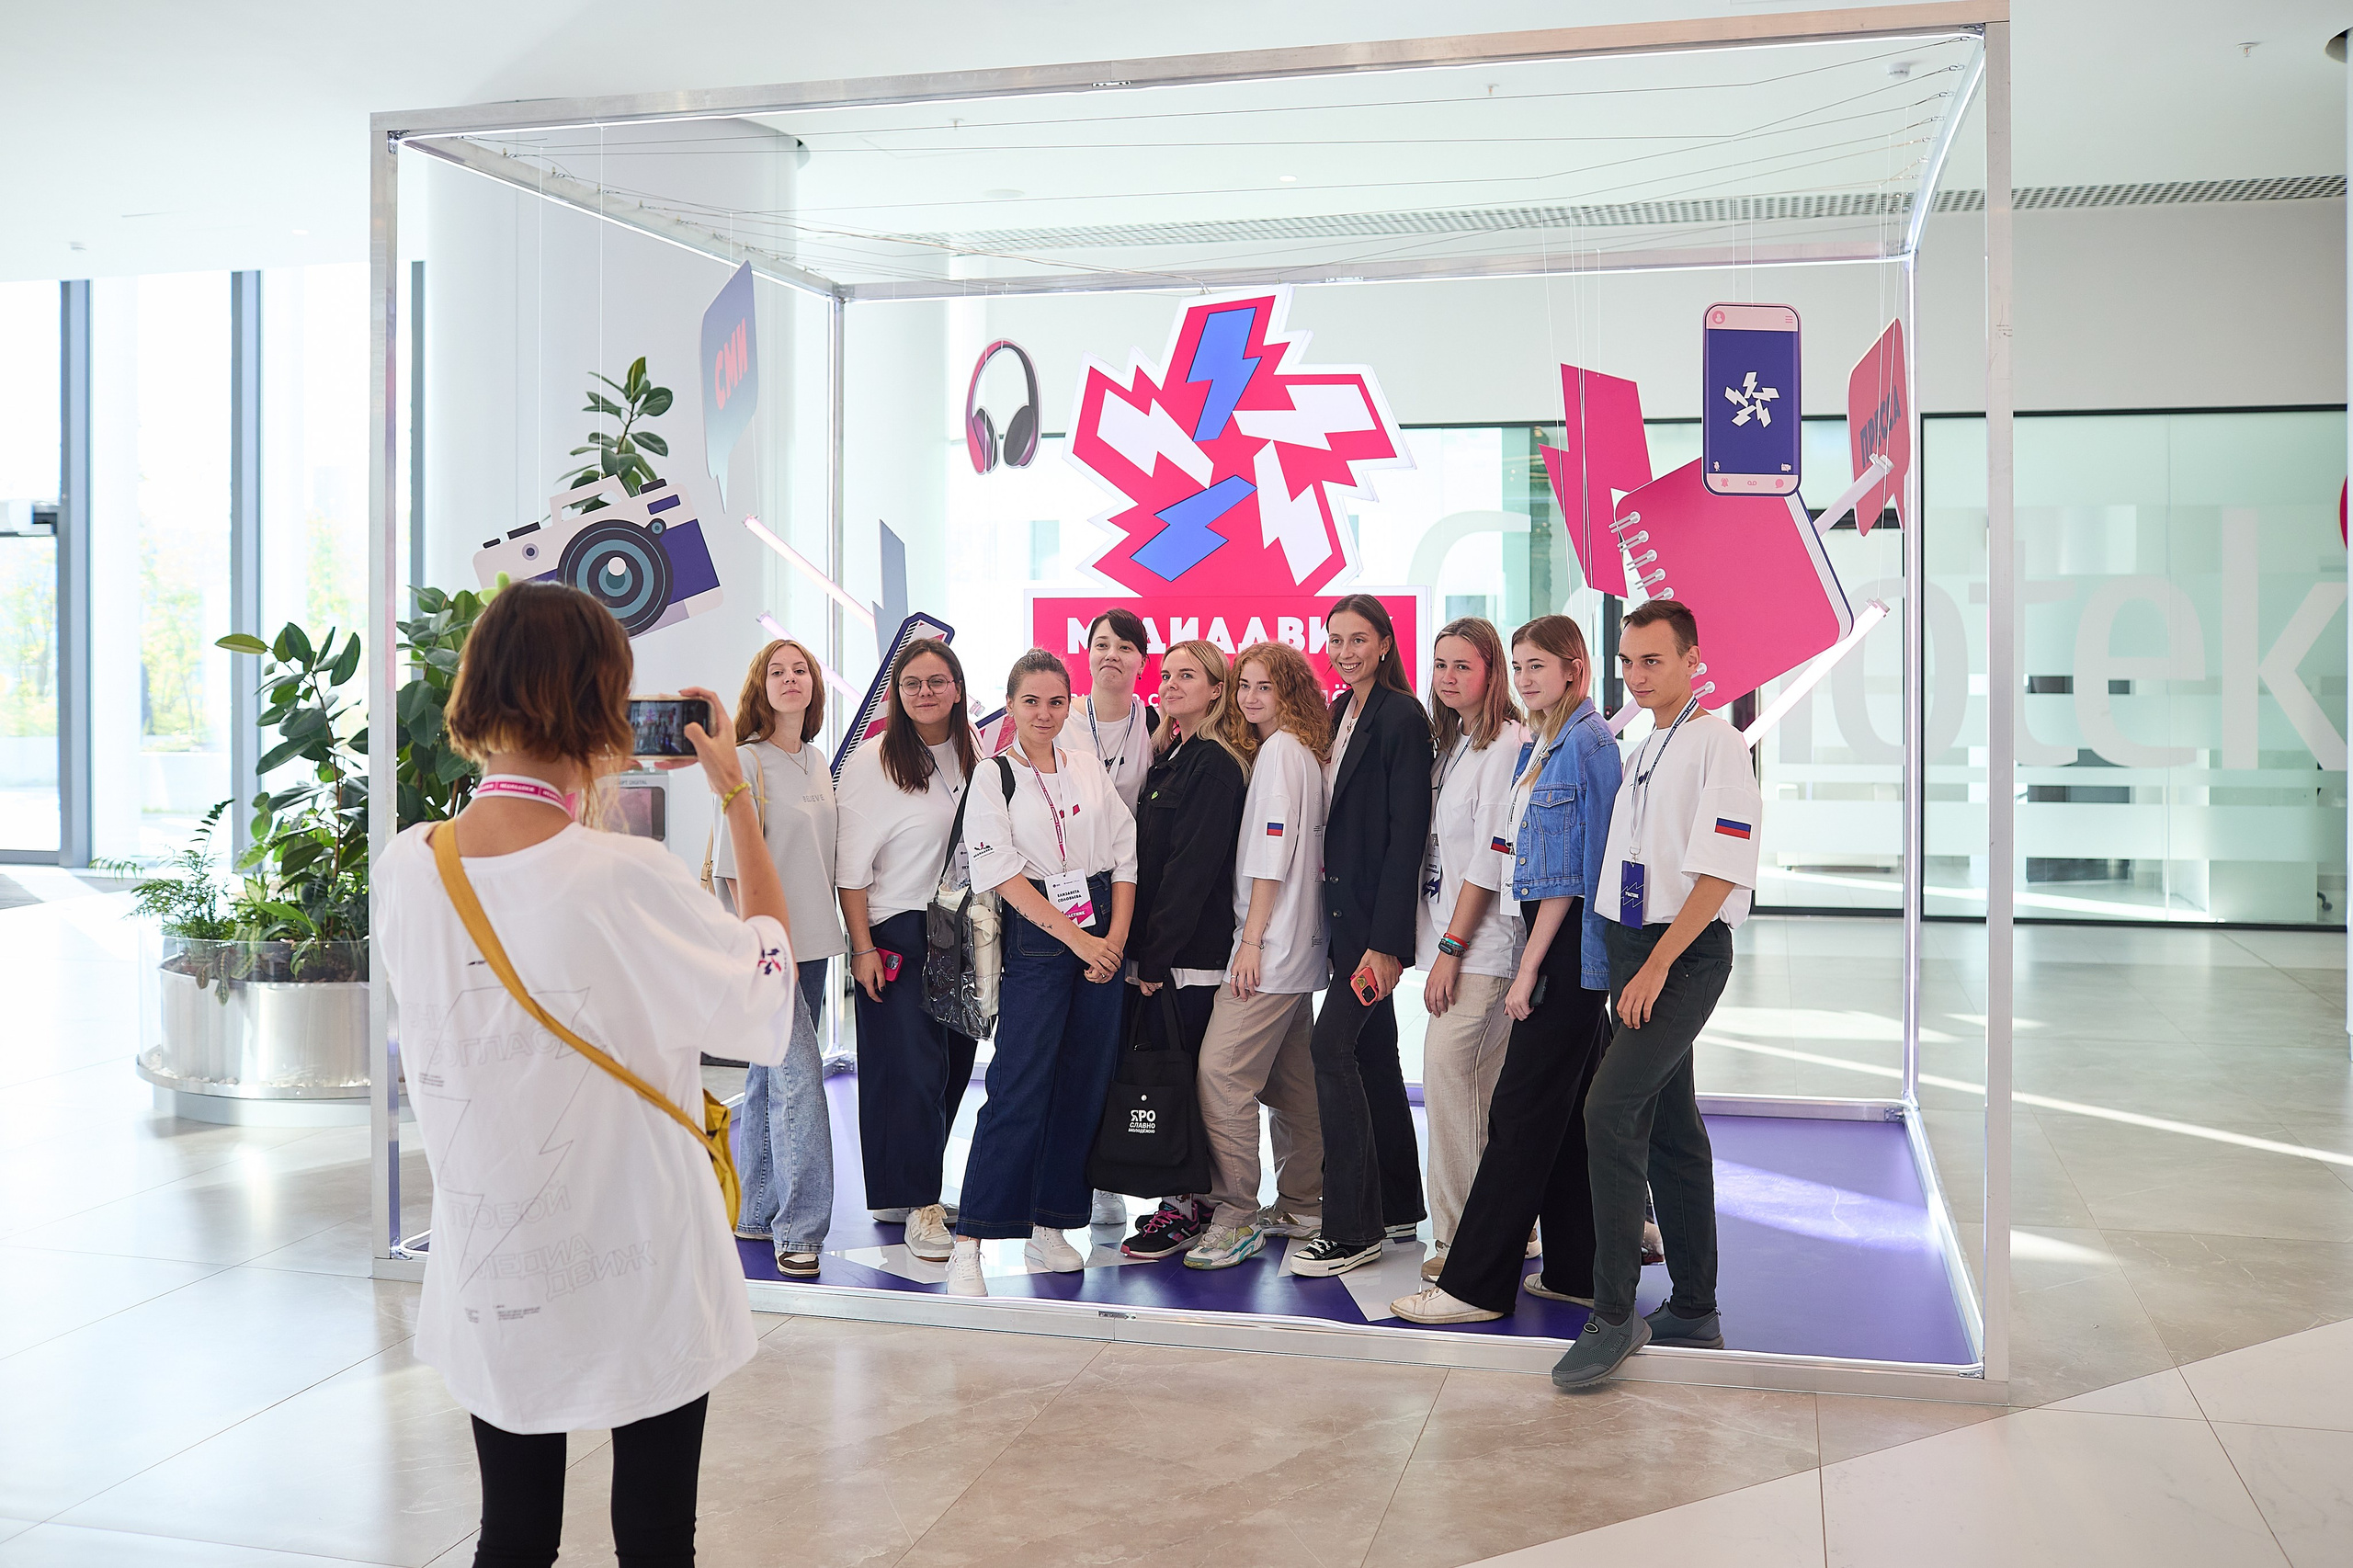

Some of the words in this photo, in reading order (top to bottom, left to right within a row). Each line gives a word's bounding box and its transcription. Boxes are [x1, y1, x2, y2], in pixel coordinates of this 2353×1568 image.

[714, 316, 748, 412] СМИ
[1859, 384, 1902, 470] ПРЕССА
[448, 1180, 573, 1230] ЛЮБОЙ
[464, 1233, 594, 1281] МЕДИА
[546, 1240, 658, 1302] ДВИЖ
